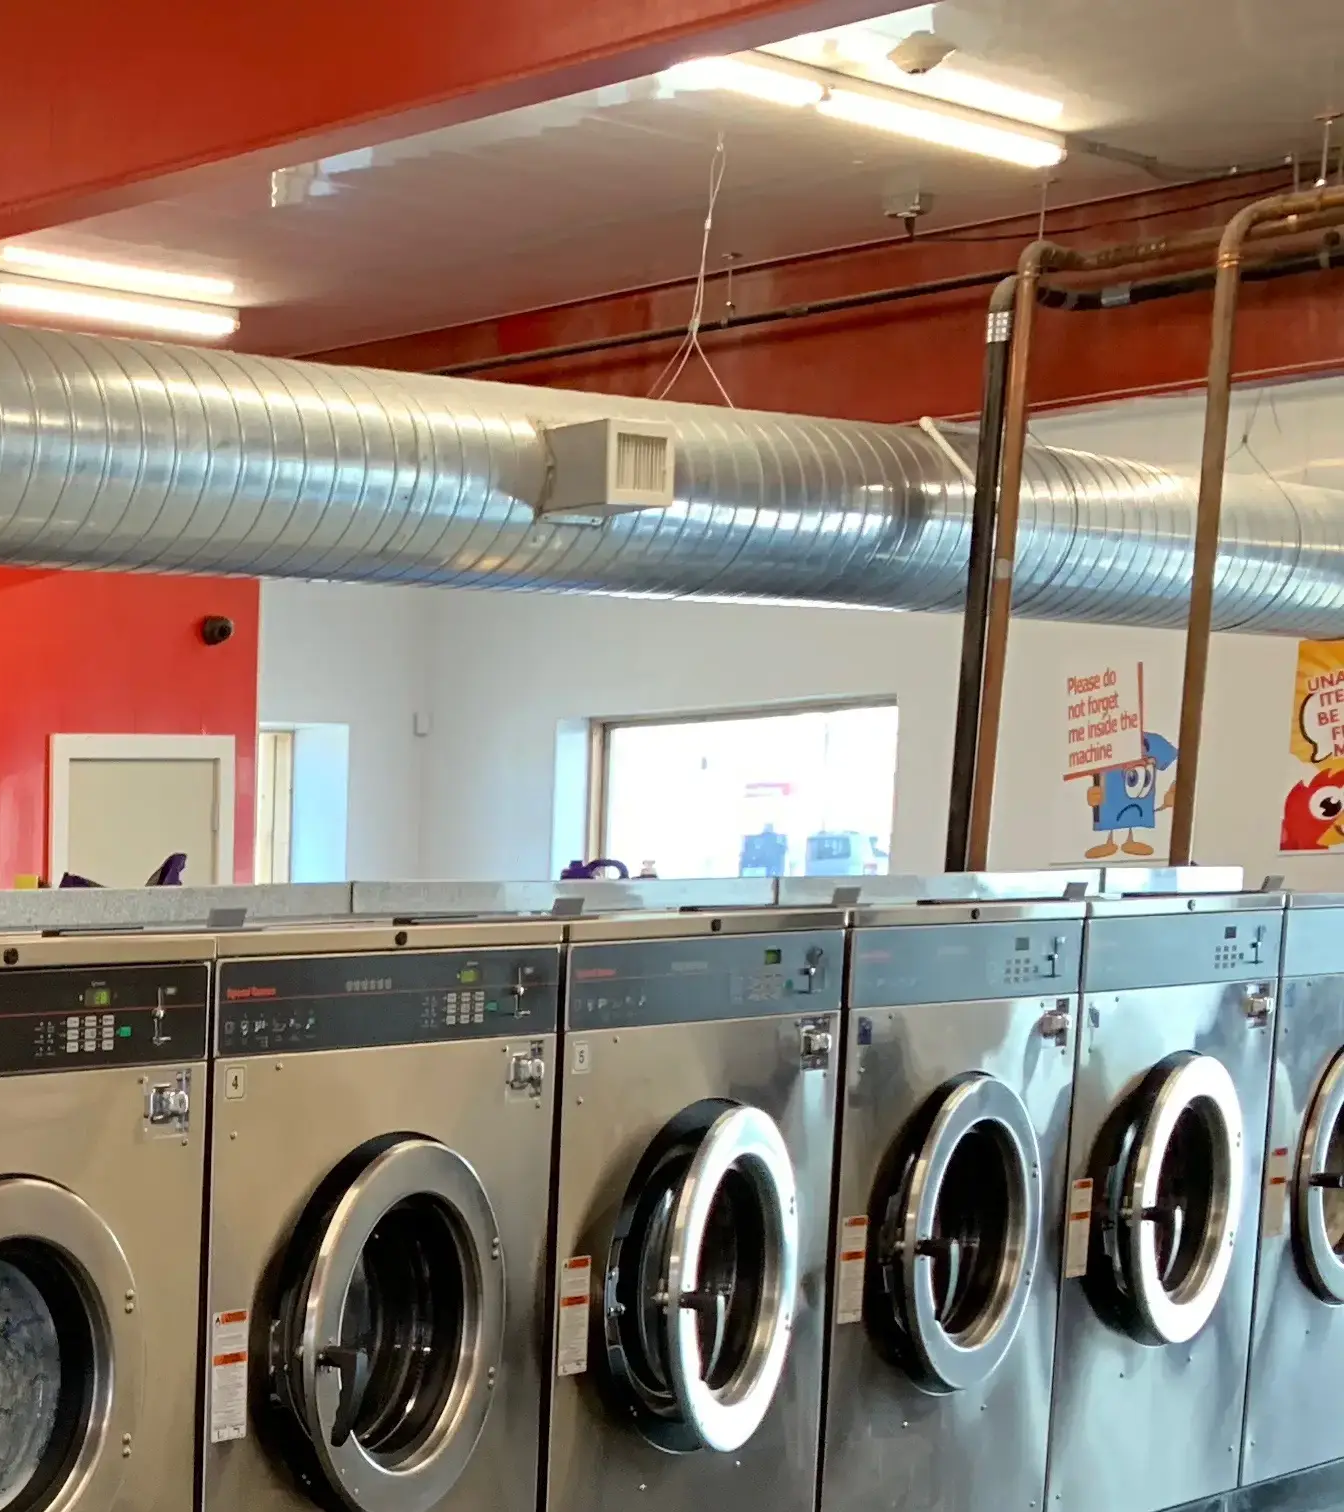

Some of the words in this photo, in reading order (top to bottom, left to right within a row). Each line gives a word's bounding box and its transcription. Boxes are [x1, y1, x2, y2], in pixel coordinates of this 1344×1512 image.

[1067, 675, 1100, 695] Please
[1103, 667, 1116, 687] do
[1068, 699, 1085, 720] not
[1088, 690, 1119, 720] forget
[1317, 708, 1340, 727] BE
[1068, 726, 1085, 744] me
[1088, 714, 1117, 740] inside
[1120, 711, 1138, 731] the
[1069, 742, 1113, 767] machine
[231, 1075, 239, 1090] 4
